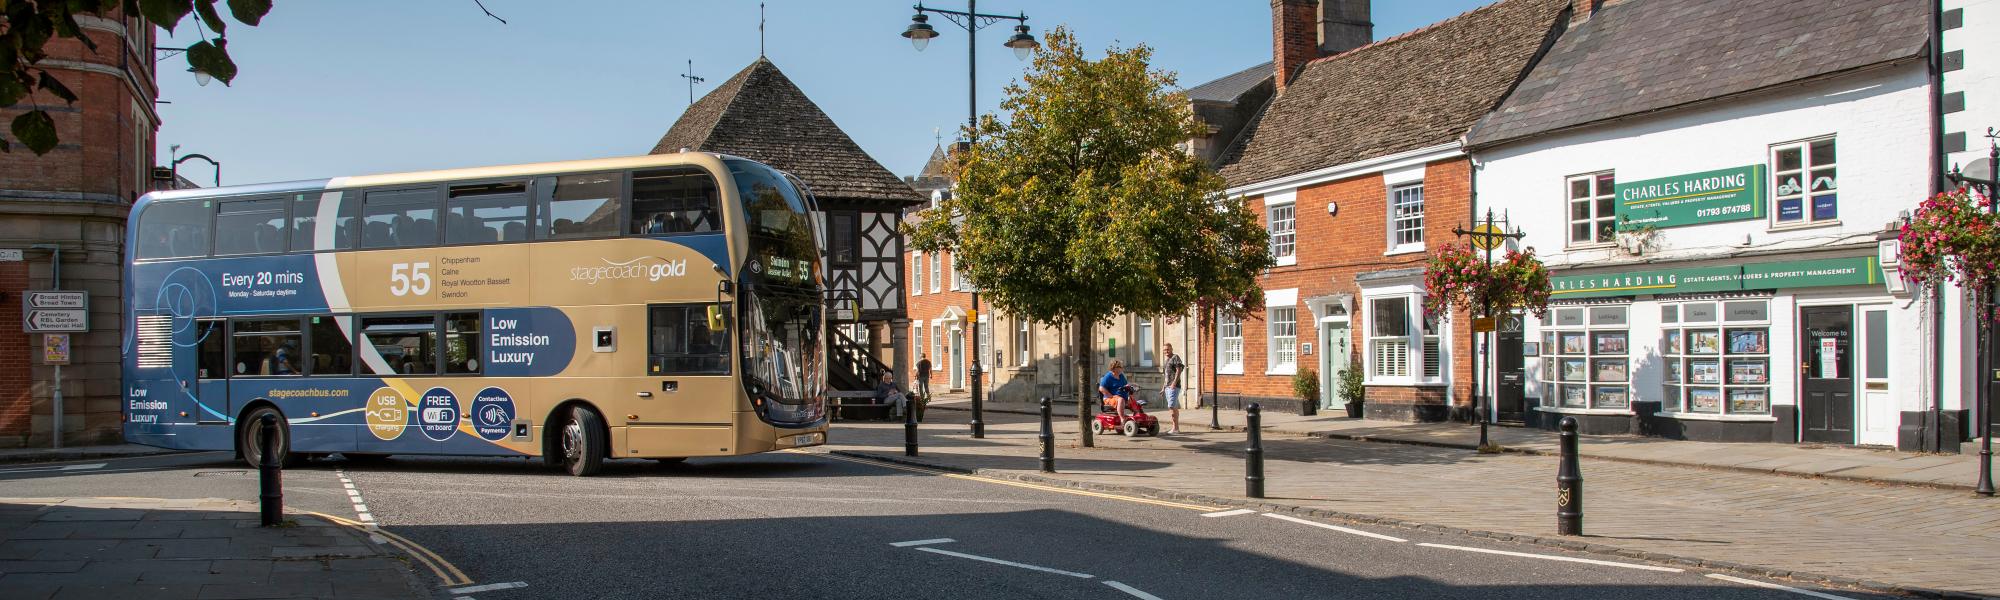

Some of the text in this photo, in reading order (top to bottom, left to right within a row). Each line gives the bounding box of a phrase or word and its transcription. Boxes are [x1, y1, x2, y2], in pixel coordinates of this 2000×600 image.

[1623, 173, 1745, 201] CHARLES HARDING
[1697, 204, 1751, 217] 01793 674788
[570, 259, 687, 285] stagecoach gold
[799, 260, 809, 280] 55
[1806, 267, 1856, 276] MANAGEMENT
[222, 270, 304, 288] Every 20 mins
[390, 262, 431, 296] 55
[441, 280, 458, 288] Royal
[1602, 274, 1676, 287] HARDING
[491, 317, 517, 330] Low
[491, 333, 550, 347] Emission
[491, 350, 535, 366] Luxury
[130, 387, 147, 397] Low
[268, 388, 349, 399] stagecoachbus.com
[130, 400, 168, 410] Emission
[377, 396, 396, 405] USB
[427, 396, 451, 405] FREE
[130, 412, 158, 424] Luxury
